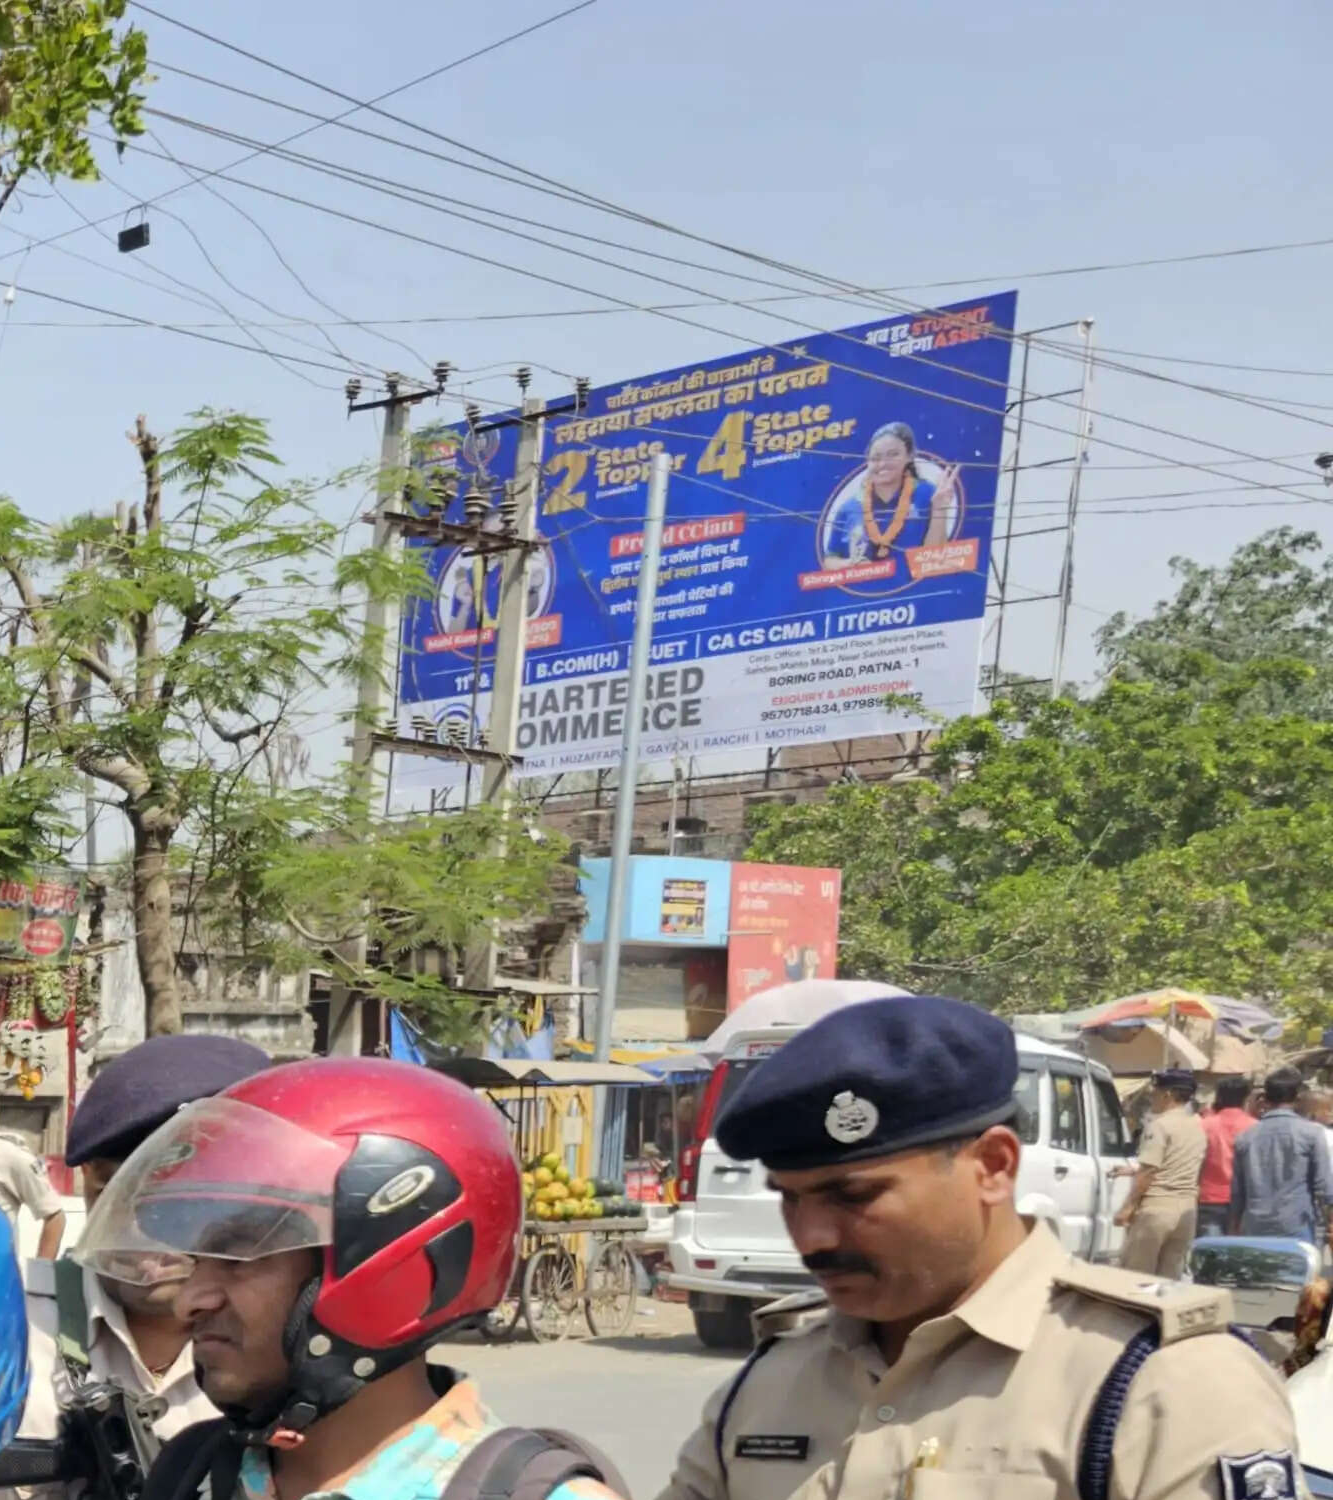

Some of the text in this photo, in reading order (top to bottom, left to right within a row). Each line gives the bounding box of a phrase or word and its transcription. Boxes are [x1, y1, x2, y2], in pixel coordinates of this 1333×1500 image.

[555, 363, 830, 443] लहराया सफलता का परचम
[753, 404, 831, 434] State
[753, 419, 856, 455] Topper
[595, 440, 664, 469] State
[837, 604, 916, 632] IT(PRO)
[649, 640, 687, 660] UET
[708, 620, 816, 651] CA CS CMA
[536, 651, 619, 680] B.COM(H)
[768, 672, 816, 688] BORING
[818, 666, 856, 681] ROAD,
[858, 660, 902, 676] PATNA
[518, 667, 704, 719] HARTEED
[515, 698, 702, 750] OMMECE
